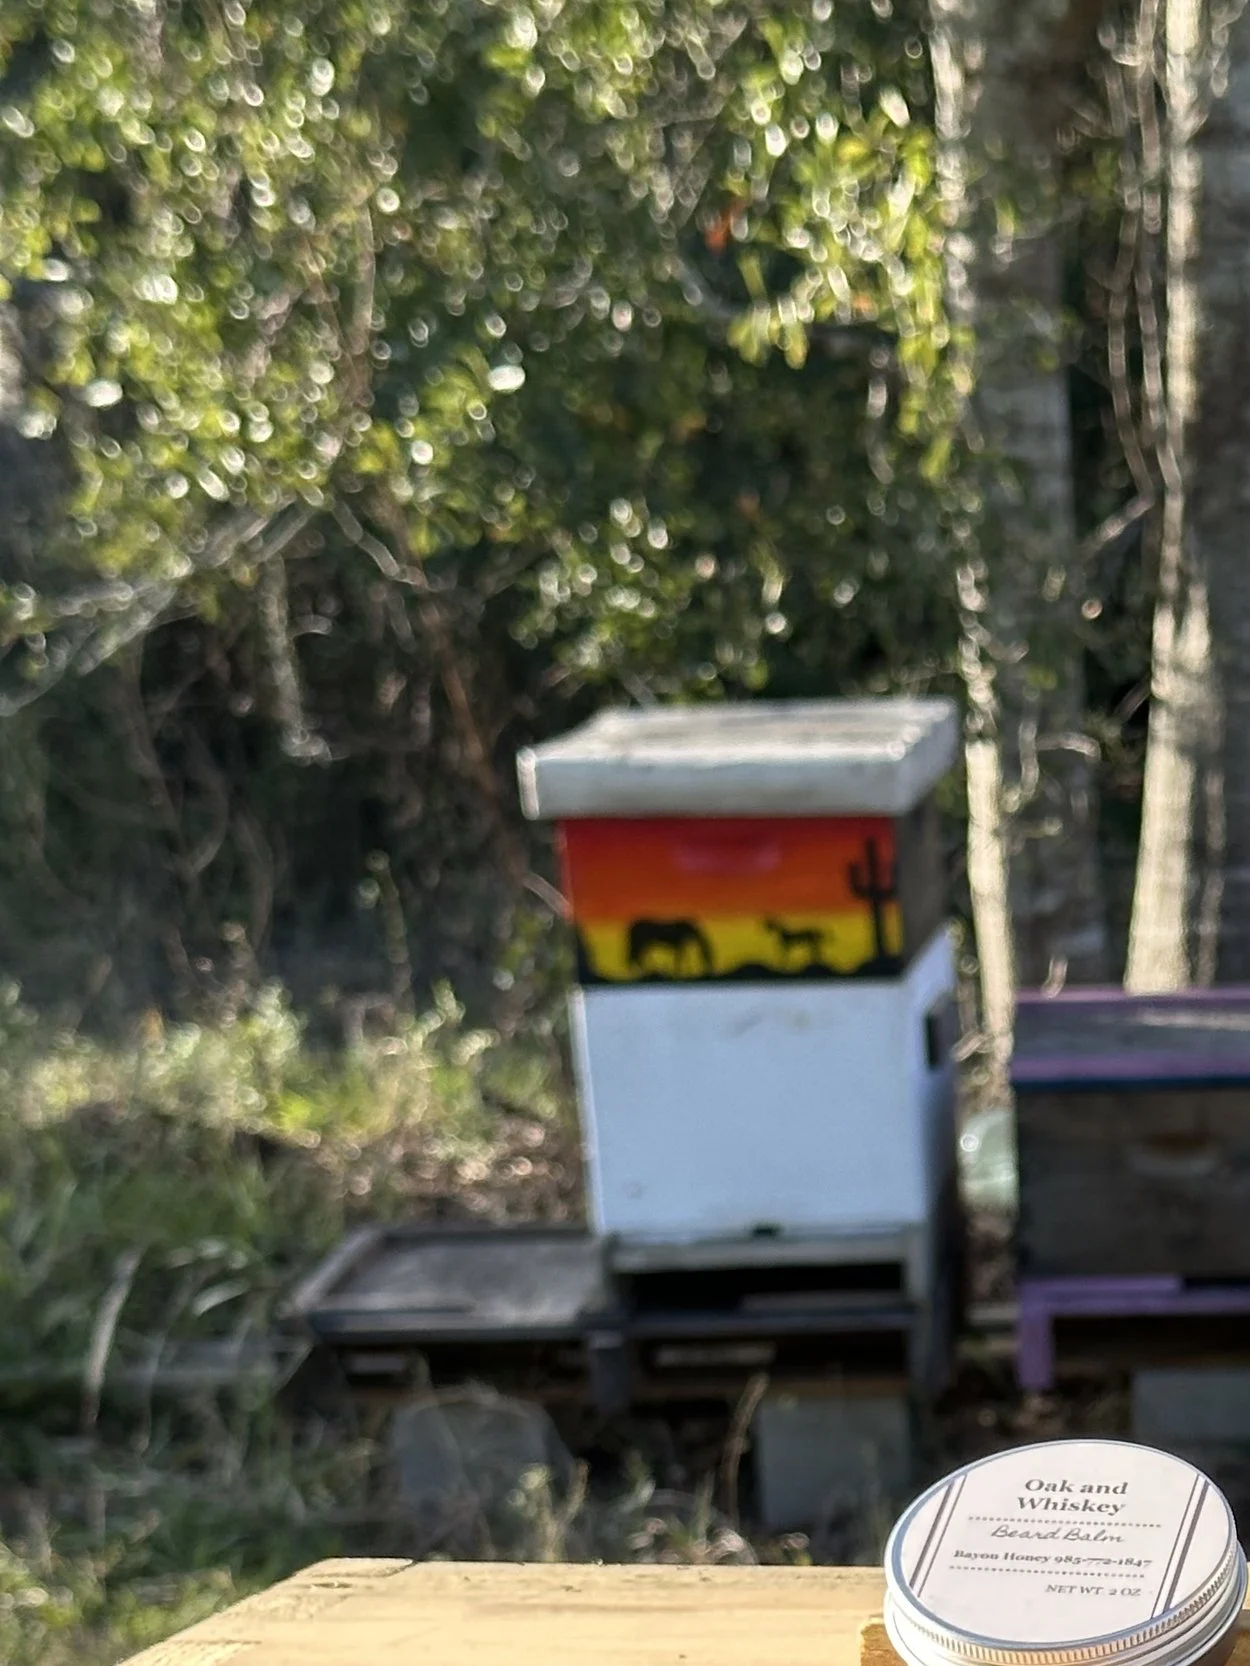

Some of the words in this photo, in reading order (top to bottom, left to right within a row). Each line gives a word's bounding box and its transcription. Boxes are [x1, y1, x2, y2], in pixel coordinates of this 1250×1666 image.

[1025, 1478, 1073, 1494] Oak
[1080, 1481, 1129, 1496] and
[1017, 1496, 1127, 1516] Whiskey
[990, 1524, 1061, 1541] Beard
[1062, 1527, 1125, 1544] Balm
[954, 1549, 999, 1562] Bayou
[1003, 1551, 1051, 1564] Honey
[1054, 1555, 1153, 1568] 985-772-1847
[1045, 1584, 1078, 1595] NET
[1109, 1588, 1118, 1596] 2
[1120, 1587, 1142, 1597] OZ
